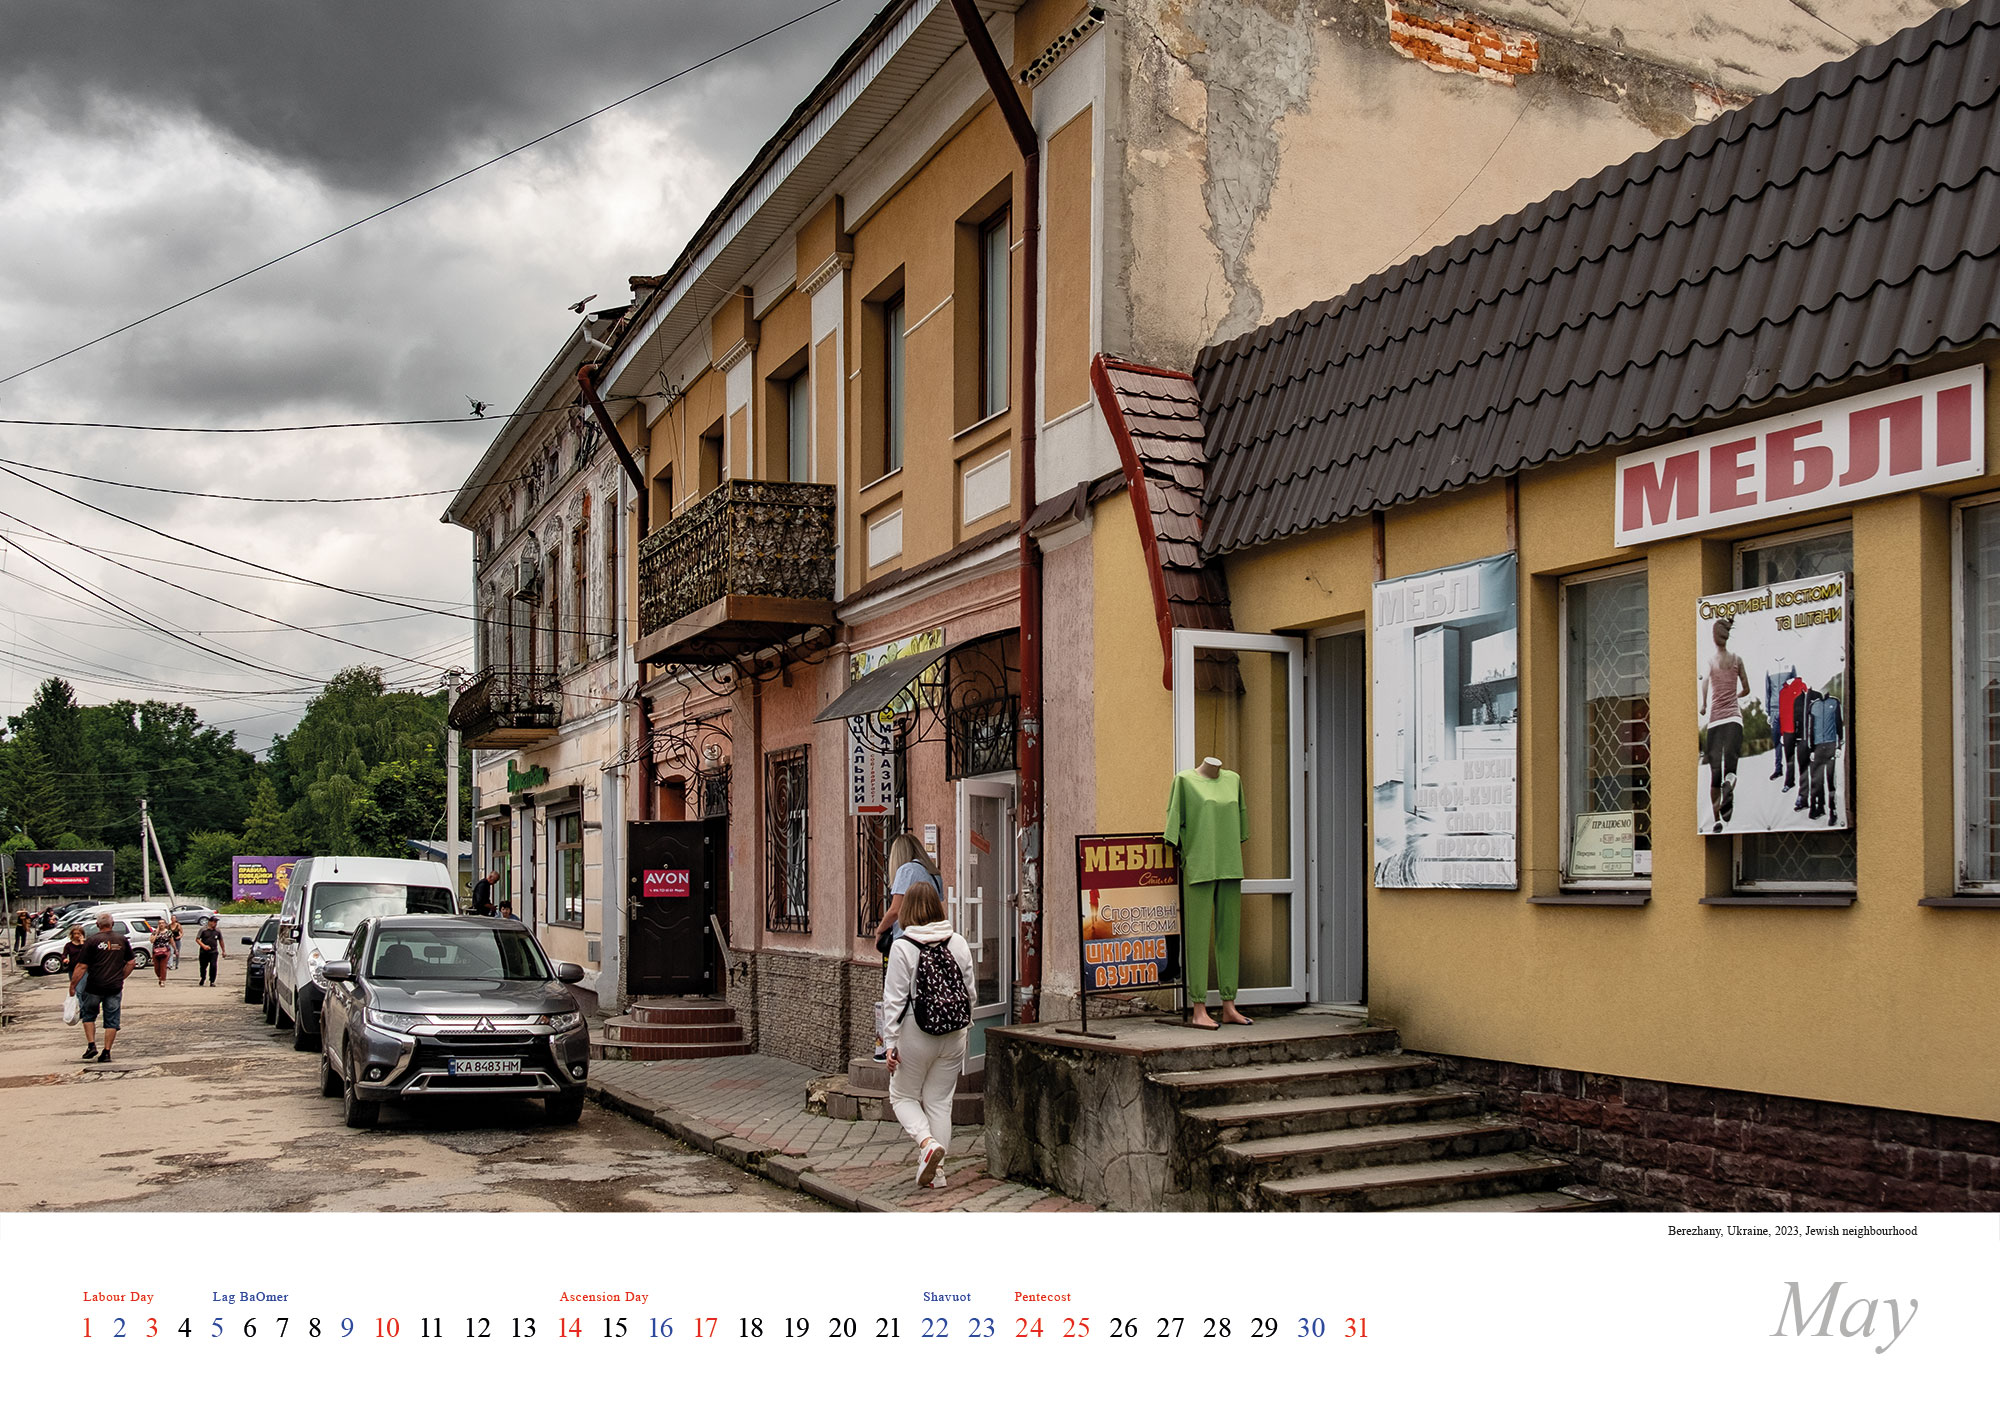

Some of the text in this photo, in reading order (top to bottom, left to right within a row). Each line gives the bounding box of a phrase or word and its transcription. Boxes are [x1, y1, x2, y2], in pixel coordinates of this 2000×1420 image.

[1622, 383, 1972, 532] МЕБЛІ
[1378, 572, 1481, 628] МЕБЛІ
[1699, 581, 1842, 620] Спортивні костюми
[1775, 606, 1842, 631] та штани
[1463, 759, 1512, 780] КУХНІ
[1446, 811, 1512, 832] СПАЛЬНІ
[1591, 819, 1632, 830] ПРАЦЮЄМО
[52, 863, 104, 872] MARKET
[1084, 843, 1174, 872] МЕБЛІ
[645, 872, 689, 884] AVON
[1101, 901, 1176, 922] Спортивні
[1112, 919, 1177, 936] костюми
[1085, 938, 1167, 965] ШКІРЯНЕ
[1095, 961, 1159, 988] ВЗУТТЯ
[474, 1061, 501, 1072] 8483
